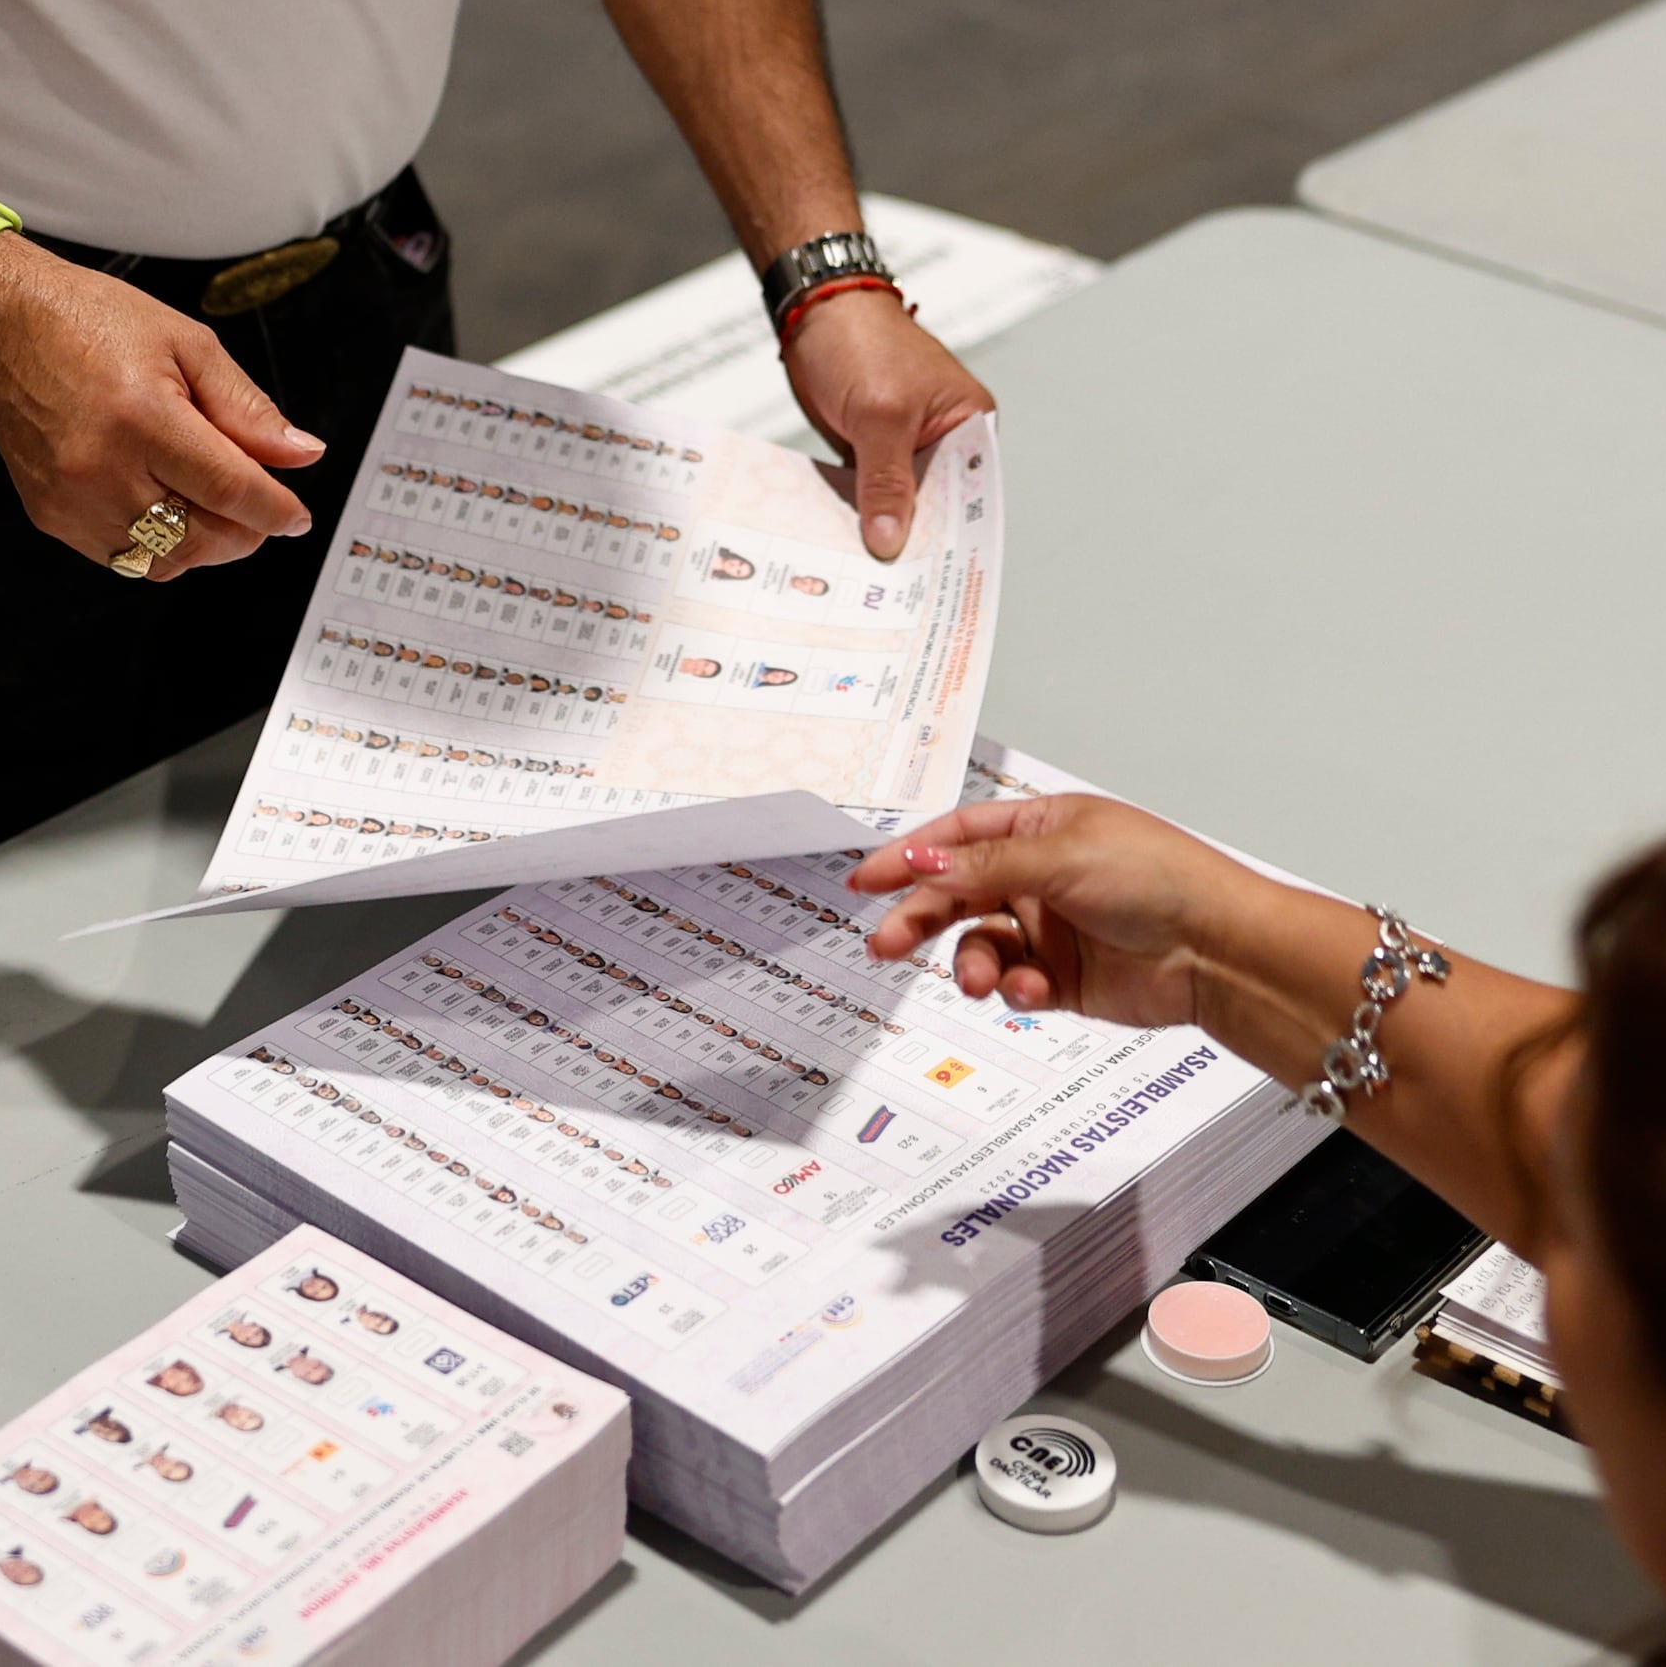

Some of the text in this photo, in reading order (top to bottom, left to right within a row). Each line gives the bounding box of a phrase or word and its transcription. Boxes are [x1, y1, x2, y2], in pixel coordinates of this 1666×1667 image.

[921, 622, 939, 660] BINOMIO
[901, 660, 929, 723] PRESIDENCIAL
[1085, 1063, 1109, 1078] (1)
[1105, 1045, 1137, 1065] UNA
[1034, 1100, 1056, 1116] DE
[1051, 1076, 1092, 1103] LISTA
[941, 1045, 1218, 1246] ASAMBLEISTAS NACIONALES
[949, 1113, 1038, 1178] ASAMBLEISTAS
[979, 1071, 1150, 1194] 15 DE OCTUBRE DE 2023
[874, 1175, 953, 1231] NACIONALES
[989, 1457, 1052, 1499] DACTILAR
[1012, 1459, 1048, 1484] CERA
